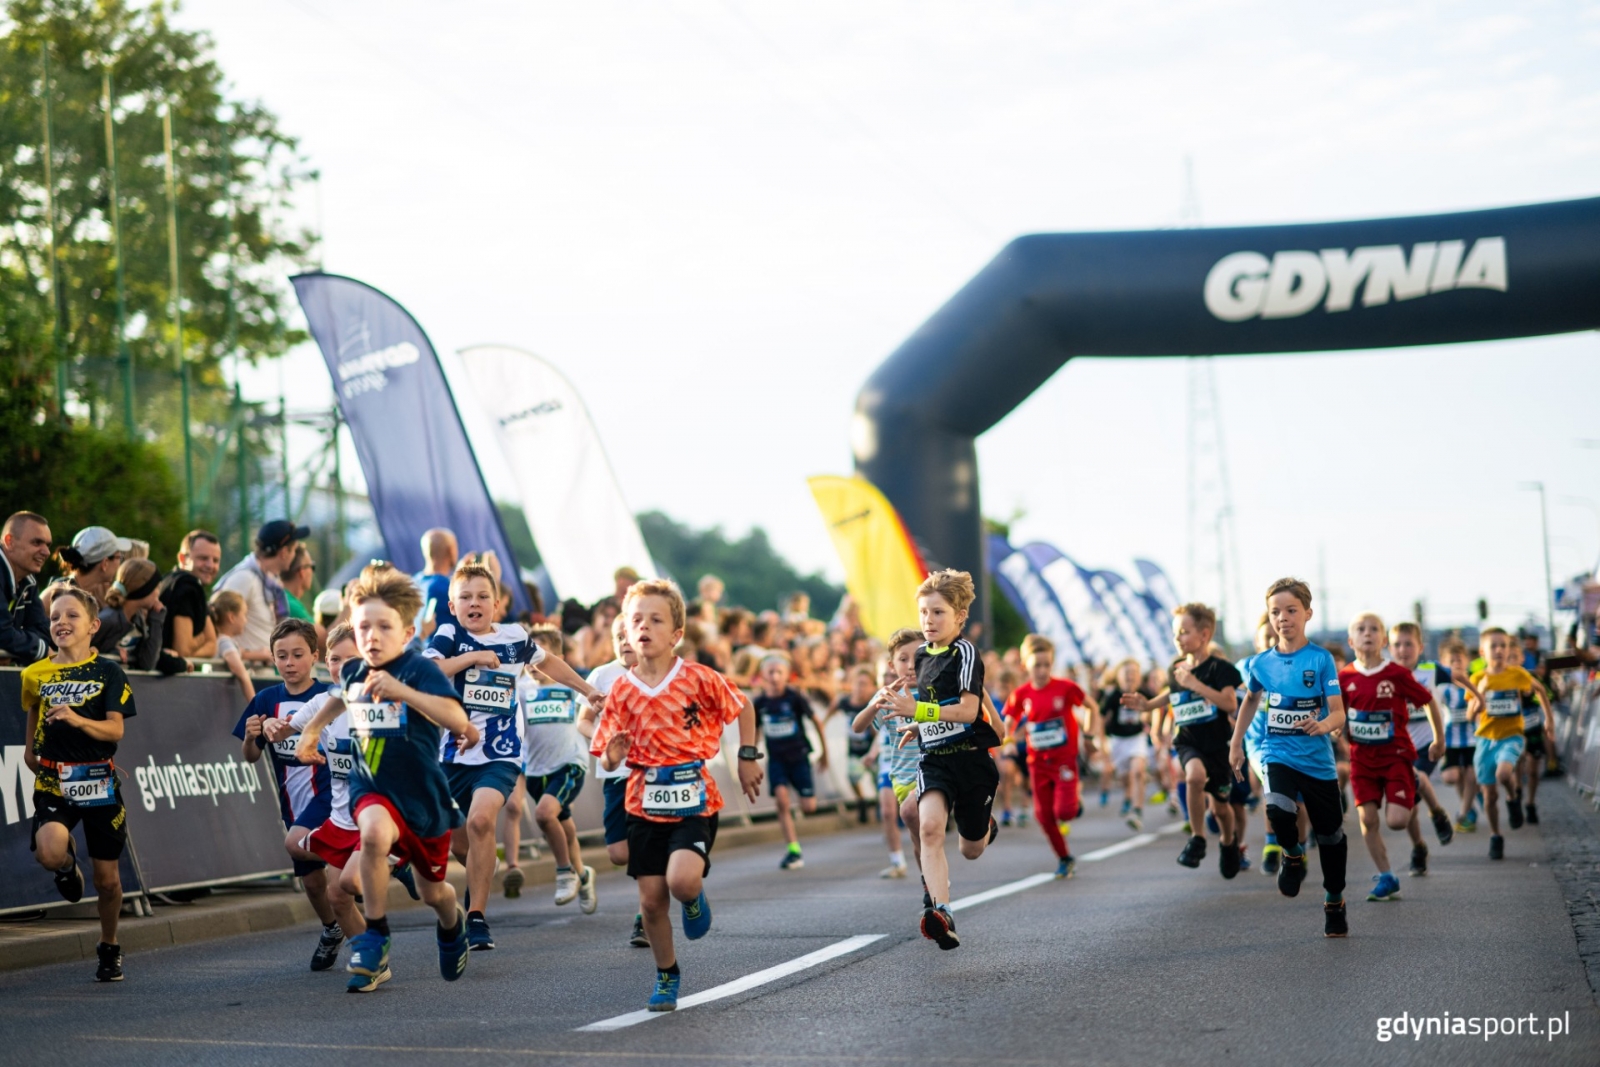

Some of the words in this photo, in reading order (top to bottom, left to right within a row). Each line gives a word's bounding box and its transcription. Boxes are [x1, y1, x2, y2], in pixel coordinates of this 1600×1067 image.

[1203, 236, 1508, 322] GDYNIA
[467, 688, 505, 703] S6005
[923, 720, 955, 737] S6050
[64, 783, 99, 797] S6001
[135, 753, 262, 812] gdyniasport.pl
[647, 789, 691, 803] S6018
